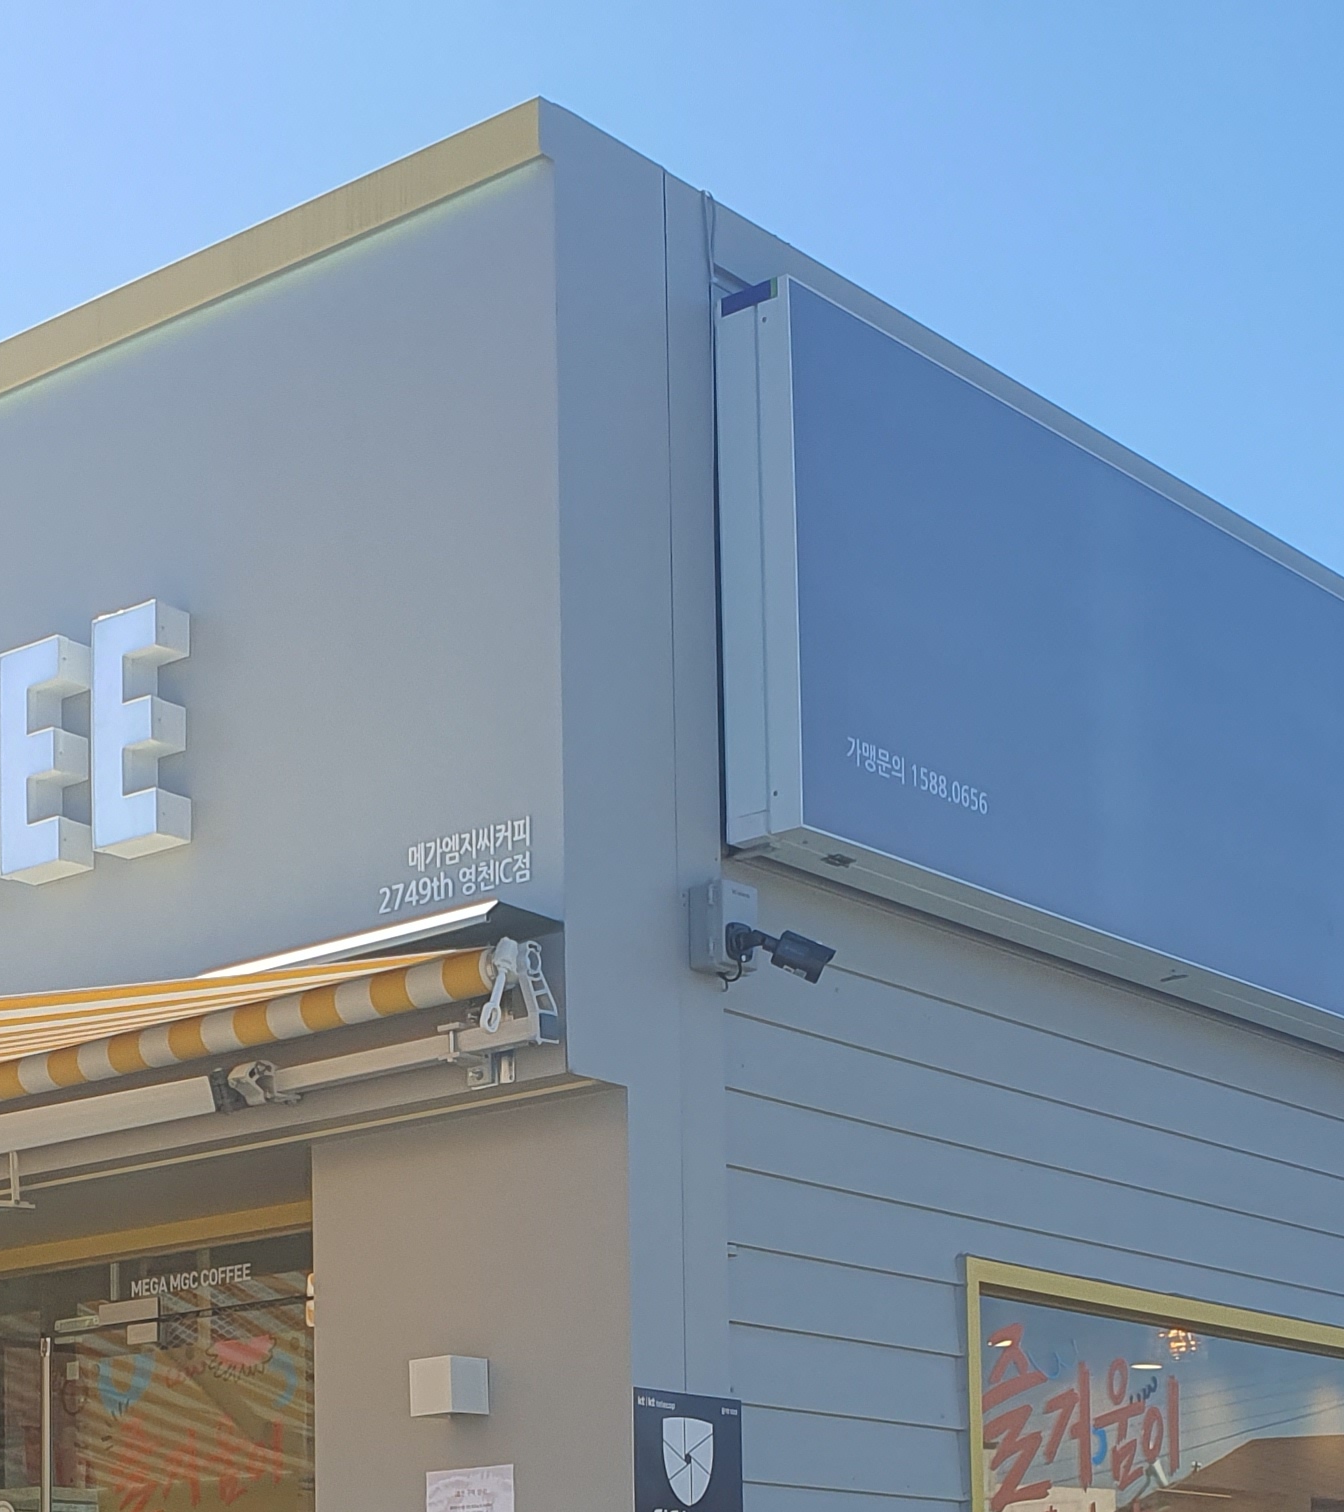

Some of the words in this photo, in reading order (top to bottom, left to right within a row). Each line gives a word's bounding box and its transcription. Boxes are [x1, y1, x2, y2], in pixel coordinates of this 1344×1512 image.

[846, 736, 905, 785] 가맹문의
[911, 764, 988, 815] 1588.0656
[408, 815, 531, 872] 메가엠지씨커피
[378, 871, 453, 914] 2749th
[459, 851, 531, 896] 영천IC점
[131, 1276, 168, 1298] MEGA
[170, 1271, 198, 1292] MGC
[200, 1263, 252, 1286] COFFEE
[982, 1323, 1180, 1512] 즐거움이
